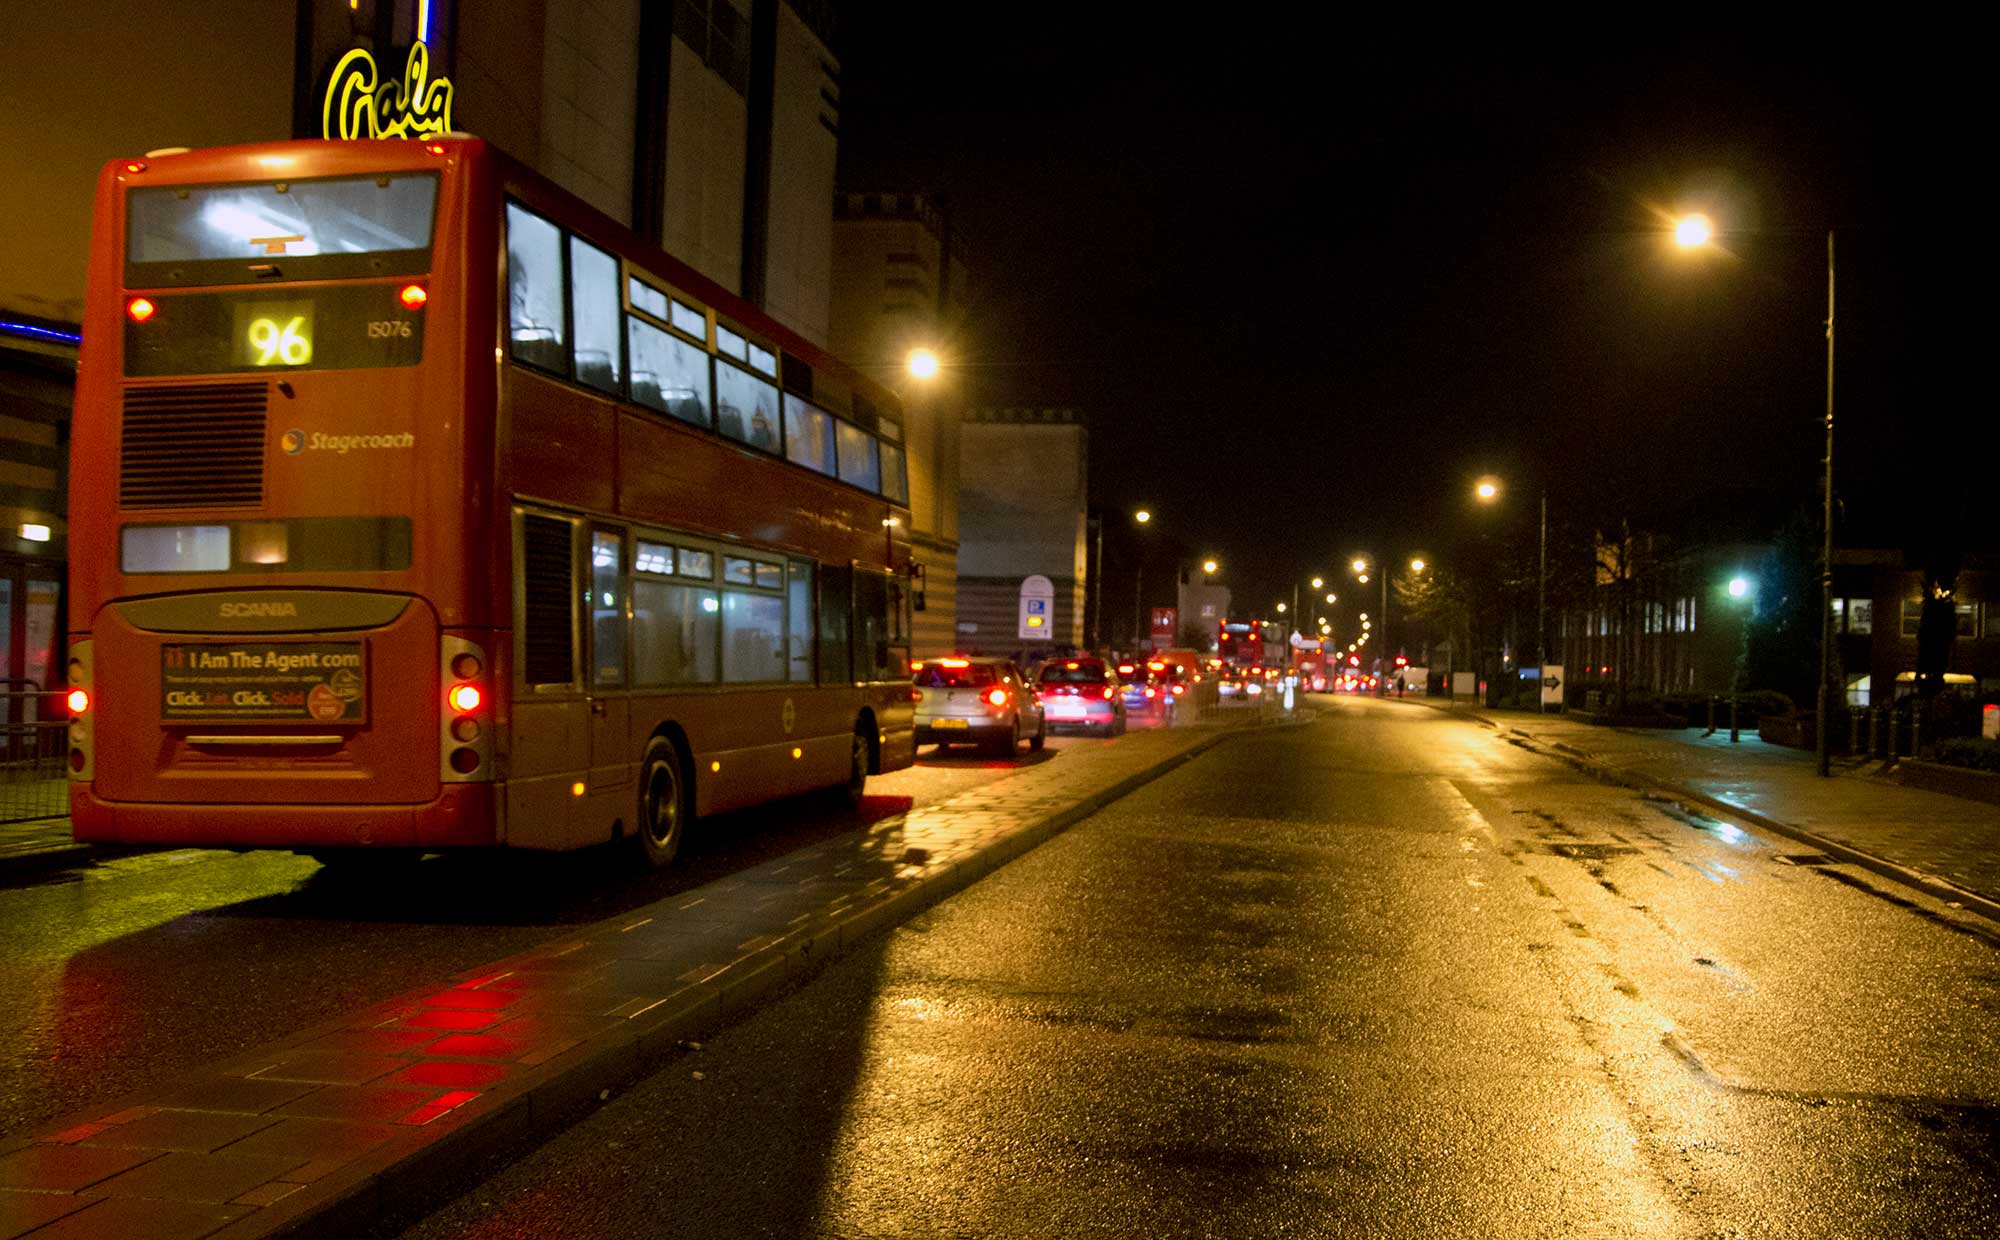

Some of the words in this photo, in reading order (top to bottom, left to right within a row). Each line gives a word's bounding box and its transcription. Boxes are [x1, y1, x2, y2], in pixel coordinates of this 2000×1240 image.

[323, 40, 454, 141] Gala
[247, 316, 313, 367] 96
[308, 431, 414, 454] Stagecoach
[219, 602, 298, 617] SCANIA
[191, 652, 197, 668] I
[200, 652, 228, 668] Am
[230, 651, 263, 668] The
